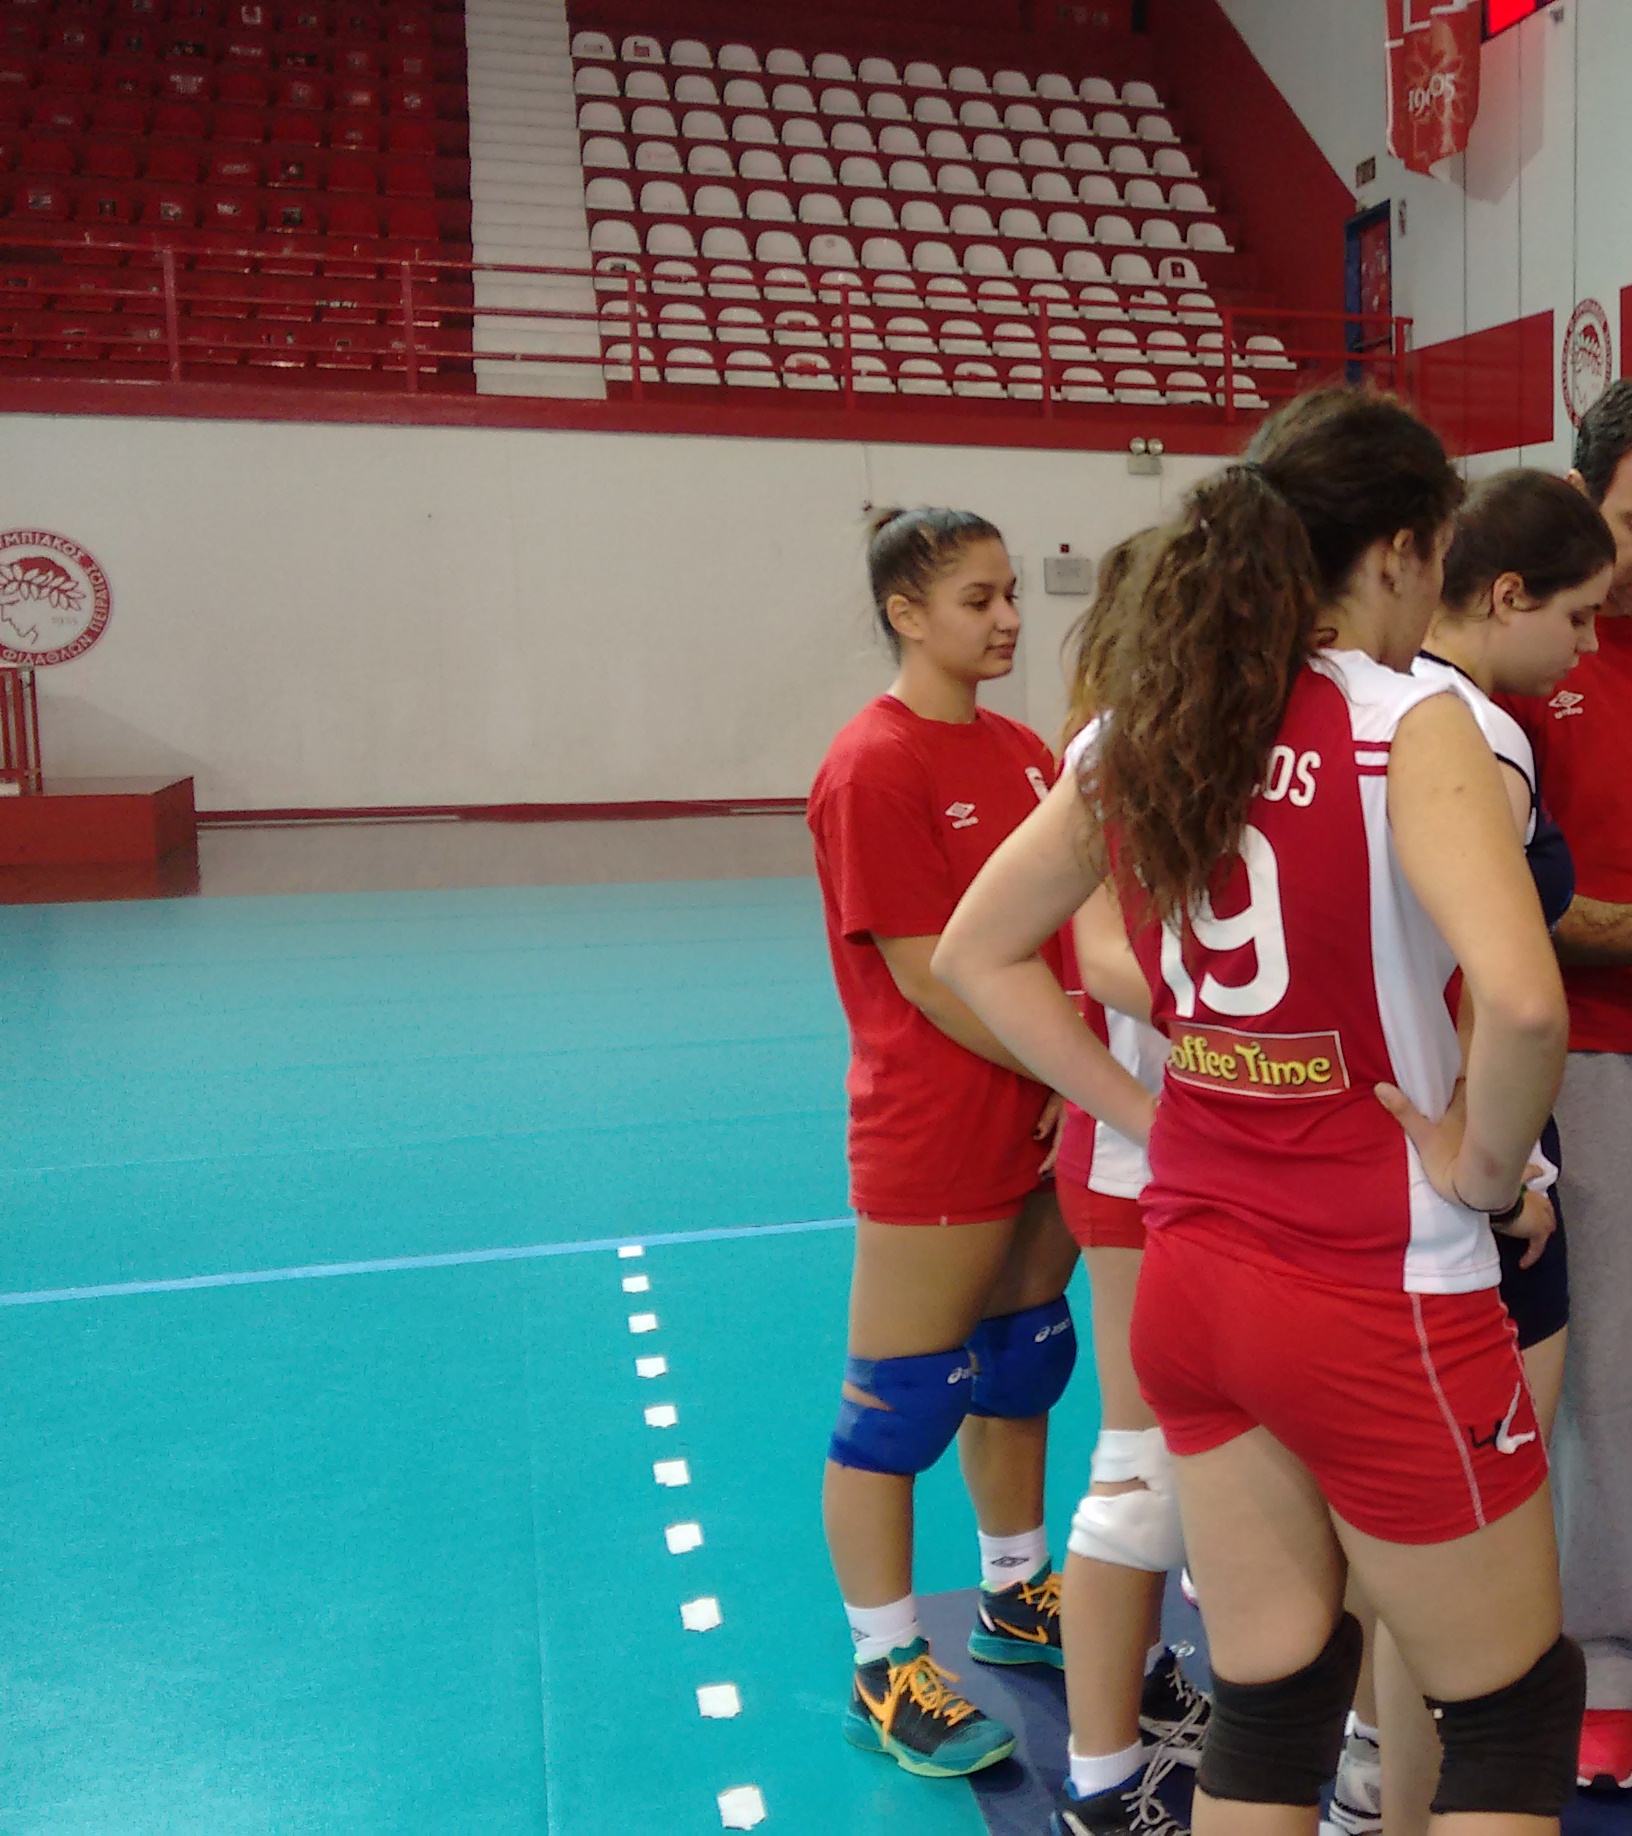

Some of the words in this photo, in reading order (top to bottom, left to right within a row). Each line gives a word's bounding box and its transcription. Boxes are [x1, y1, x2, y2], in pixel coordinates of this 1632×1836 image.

[0, 532, 85, 563] ΜΠΙΑΚΟΣ
[1251, 745, 1321, 807] OS
[1161, 824, 1290, 1018] 19
[1170, 1036, 1238, 1081] offee
[1235, 1042, 1331, 1086] Time
